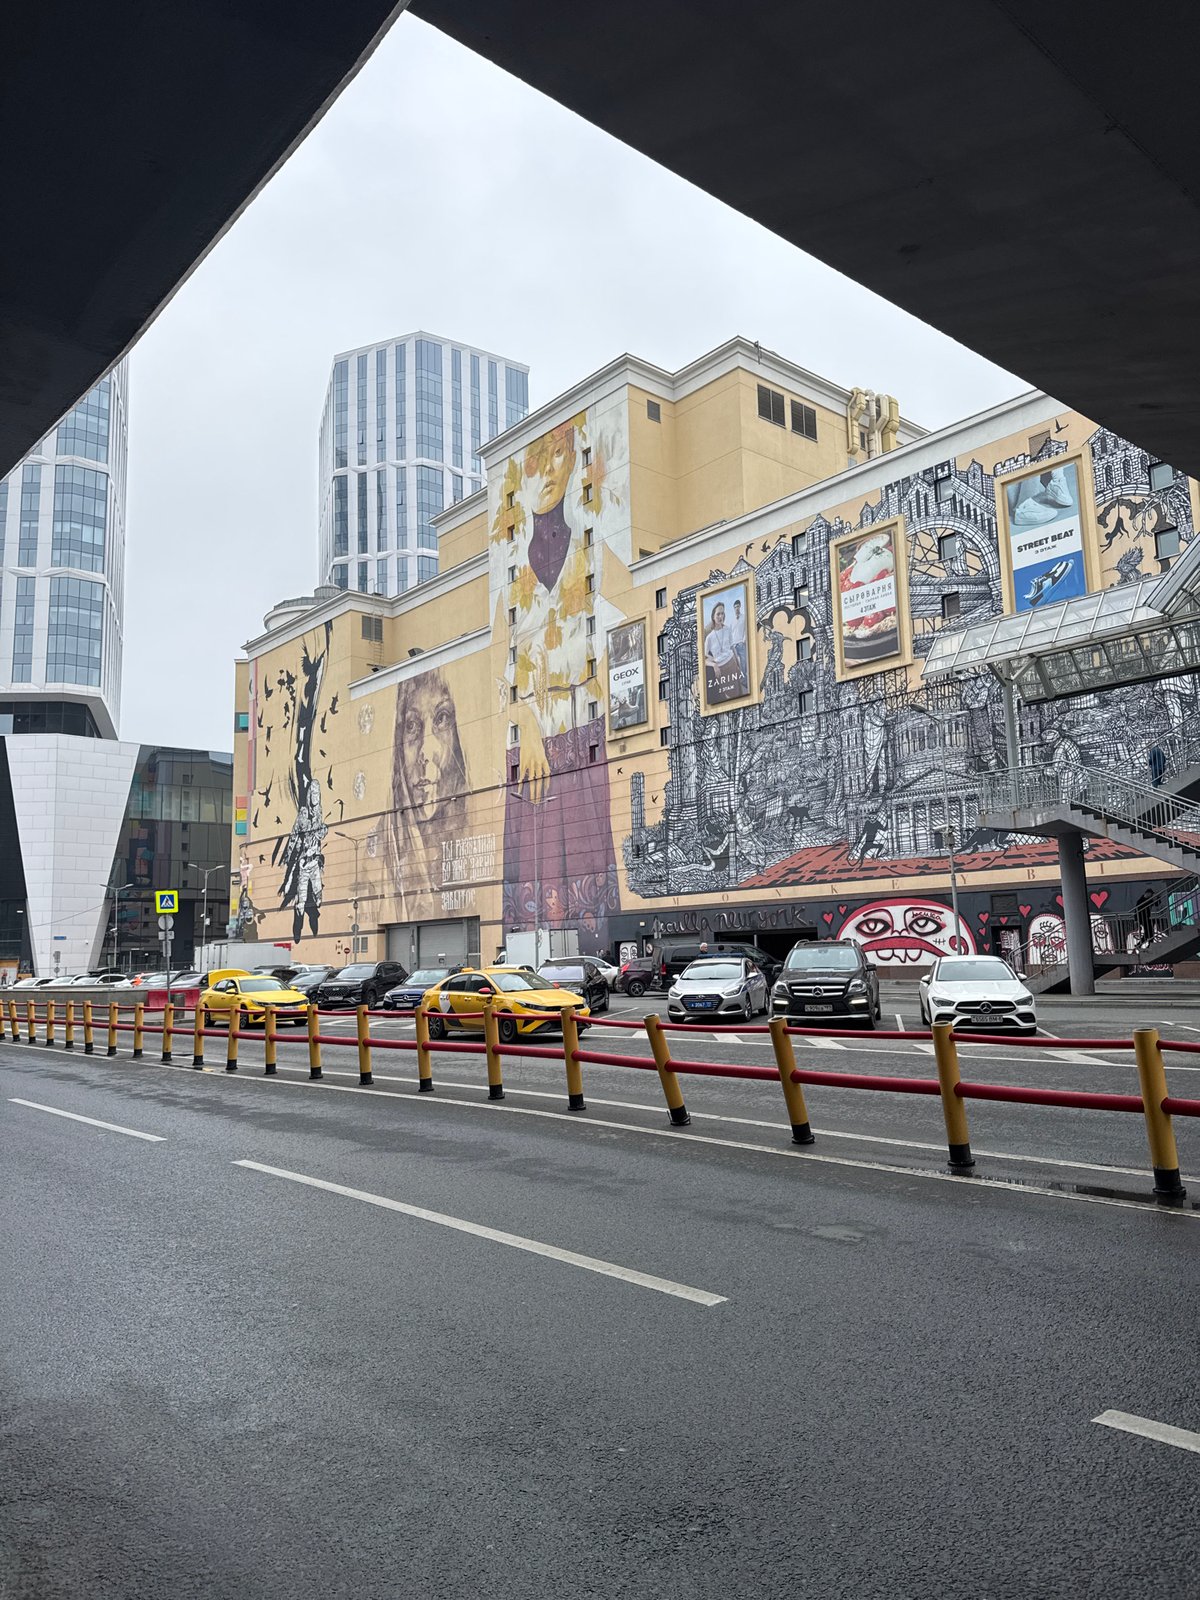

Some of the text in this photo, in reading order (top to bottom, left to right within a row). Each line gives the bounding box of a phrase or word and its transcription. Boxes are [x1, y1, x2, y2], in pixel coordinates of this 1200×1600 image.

[1016, 529, 1074, 553] STREET BEAT
[613, 666, 639, 682] GEOX
[708, 671, 745, 688] ZARINA
